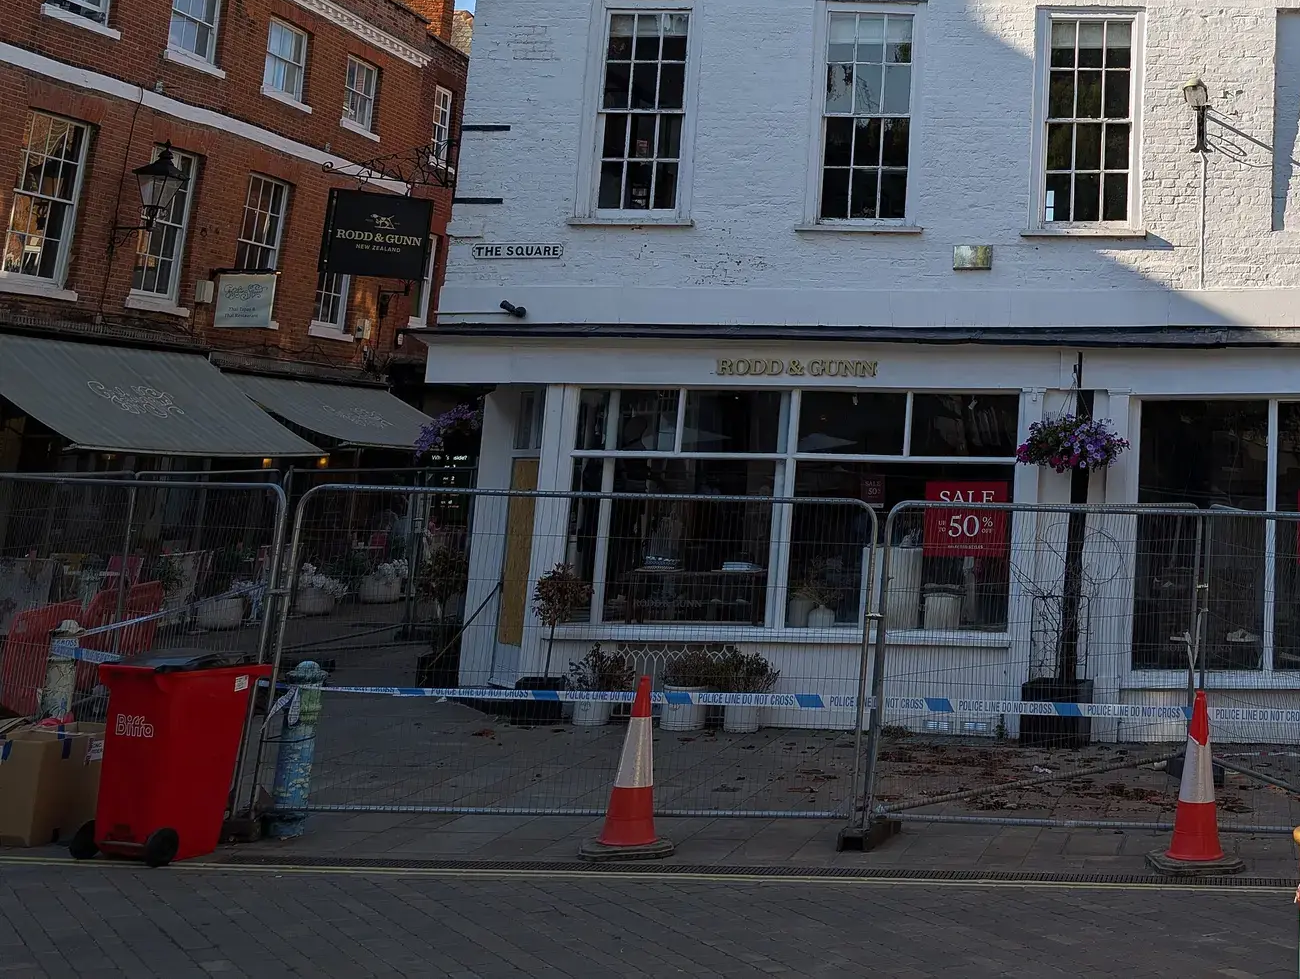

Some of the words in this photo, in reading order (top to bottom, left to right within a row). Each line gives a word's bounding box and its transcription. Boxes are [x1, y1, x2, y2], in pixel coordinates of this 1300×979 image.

[336, 229, 373, 241] RODD
[374, 234, 384, 242] &
[386, 234, 422, 246] GUNN
[372, 245, 400, 253] ZEALAND
[476, 246, 501, 256] THE
[506, 246, 559, 256] SQUARE
[716, 359, 784, 375] RODD
[787, 360, 804, 376] &
[809, 360, 878, 377] GUNN
[940, 490, 995, 502] SALE
[565, 691, 590, 700] POLICE
[592, 691, 608, 701] LINE
[610, 692, 619, 701] DO
[698, 694, 723, 704] POLICE
[725, 694, 740, 704] LINE
[742, 695, 752, 704] DO
[754, 695, 768, 705] NOT
[770, 695, 793, 705] CROSS
[830, 696, 854, 706] POLICE
[885, 698, 899, 708] NOT
[902, 698, 924, 709] CROSS
[959, 700, 983, 711] POLICE
[985, 701, 1000, 712] LINE
[1002, 702, 1012, 712] DO
[1014, 702, 1028, 713] NOT
[1030, 703, 1052, 714] CROSS
[1087, 705, 1111, 716] POLICE
[1114, 706, 1128, 717] LINE
[1130, 706, 1140, 717] DO
[1142, 706, 1156, 717] NOT
[1158, 707, 1180, 718] CROSS
[1215, 709, 1240, 720] POLICE
[1241, 709, 1256, 721] LINE
[1258, 710, 1268, 721] DO
[1270, 710, 1284, 721] NOT
[115, 714, 154, 738] Biffa
